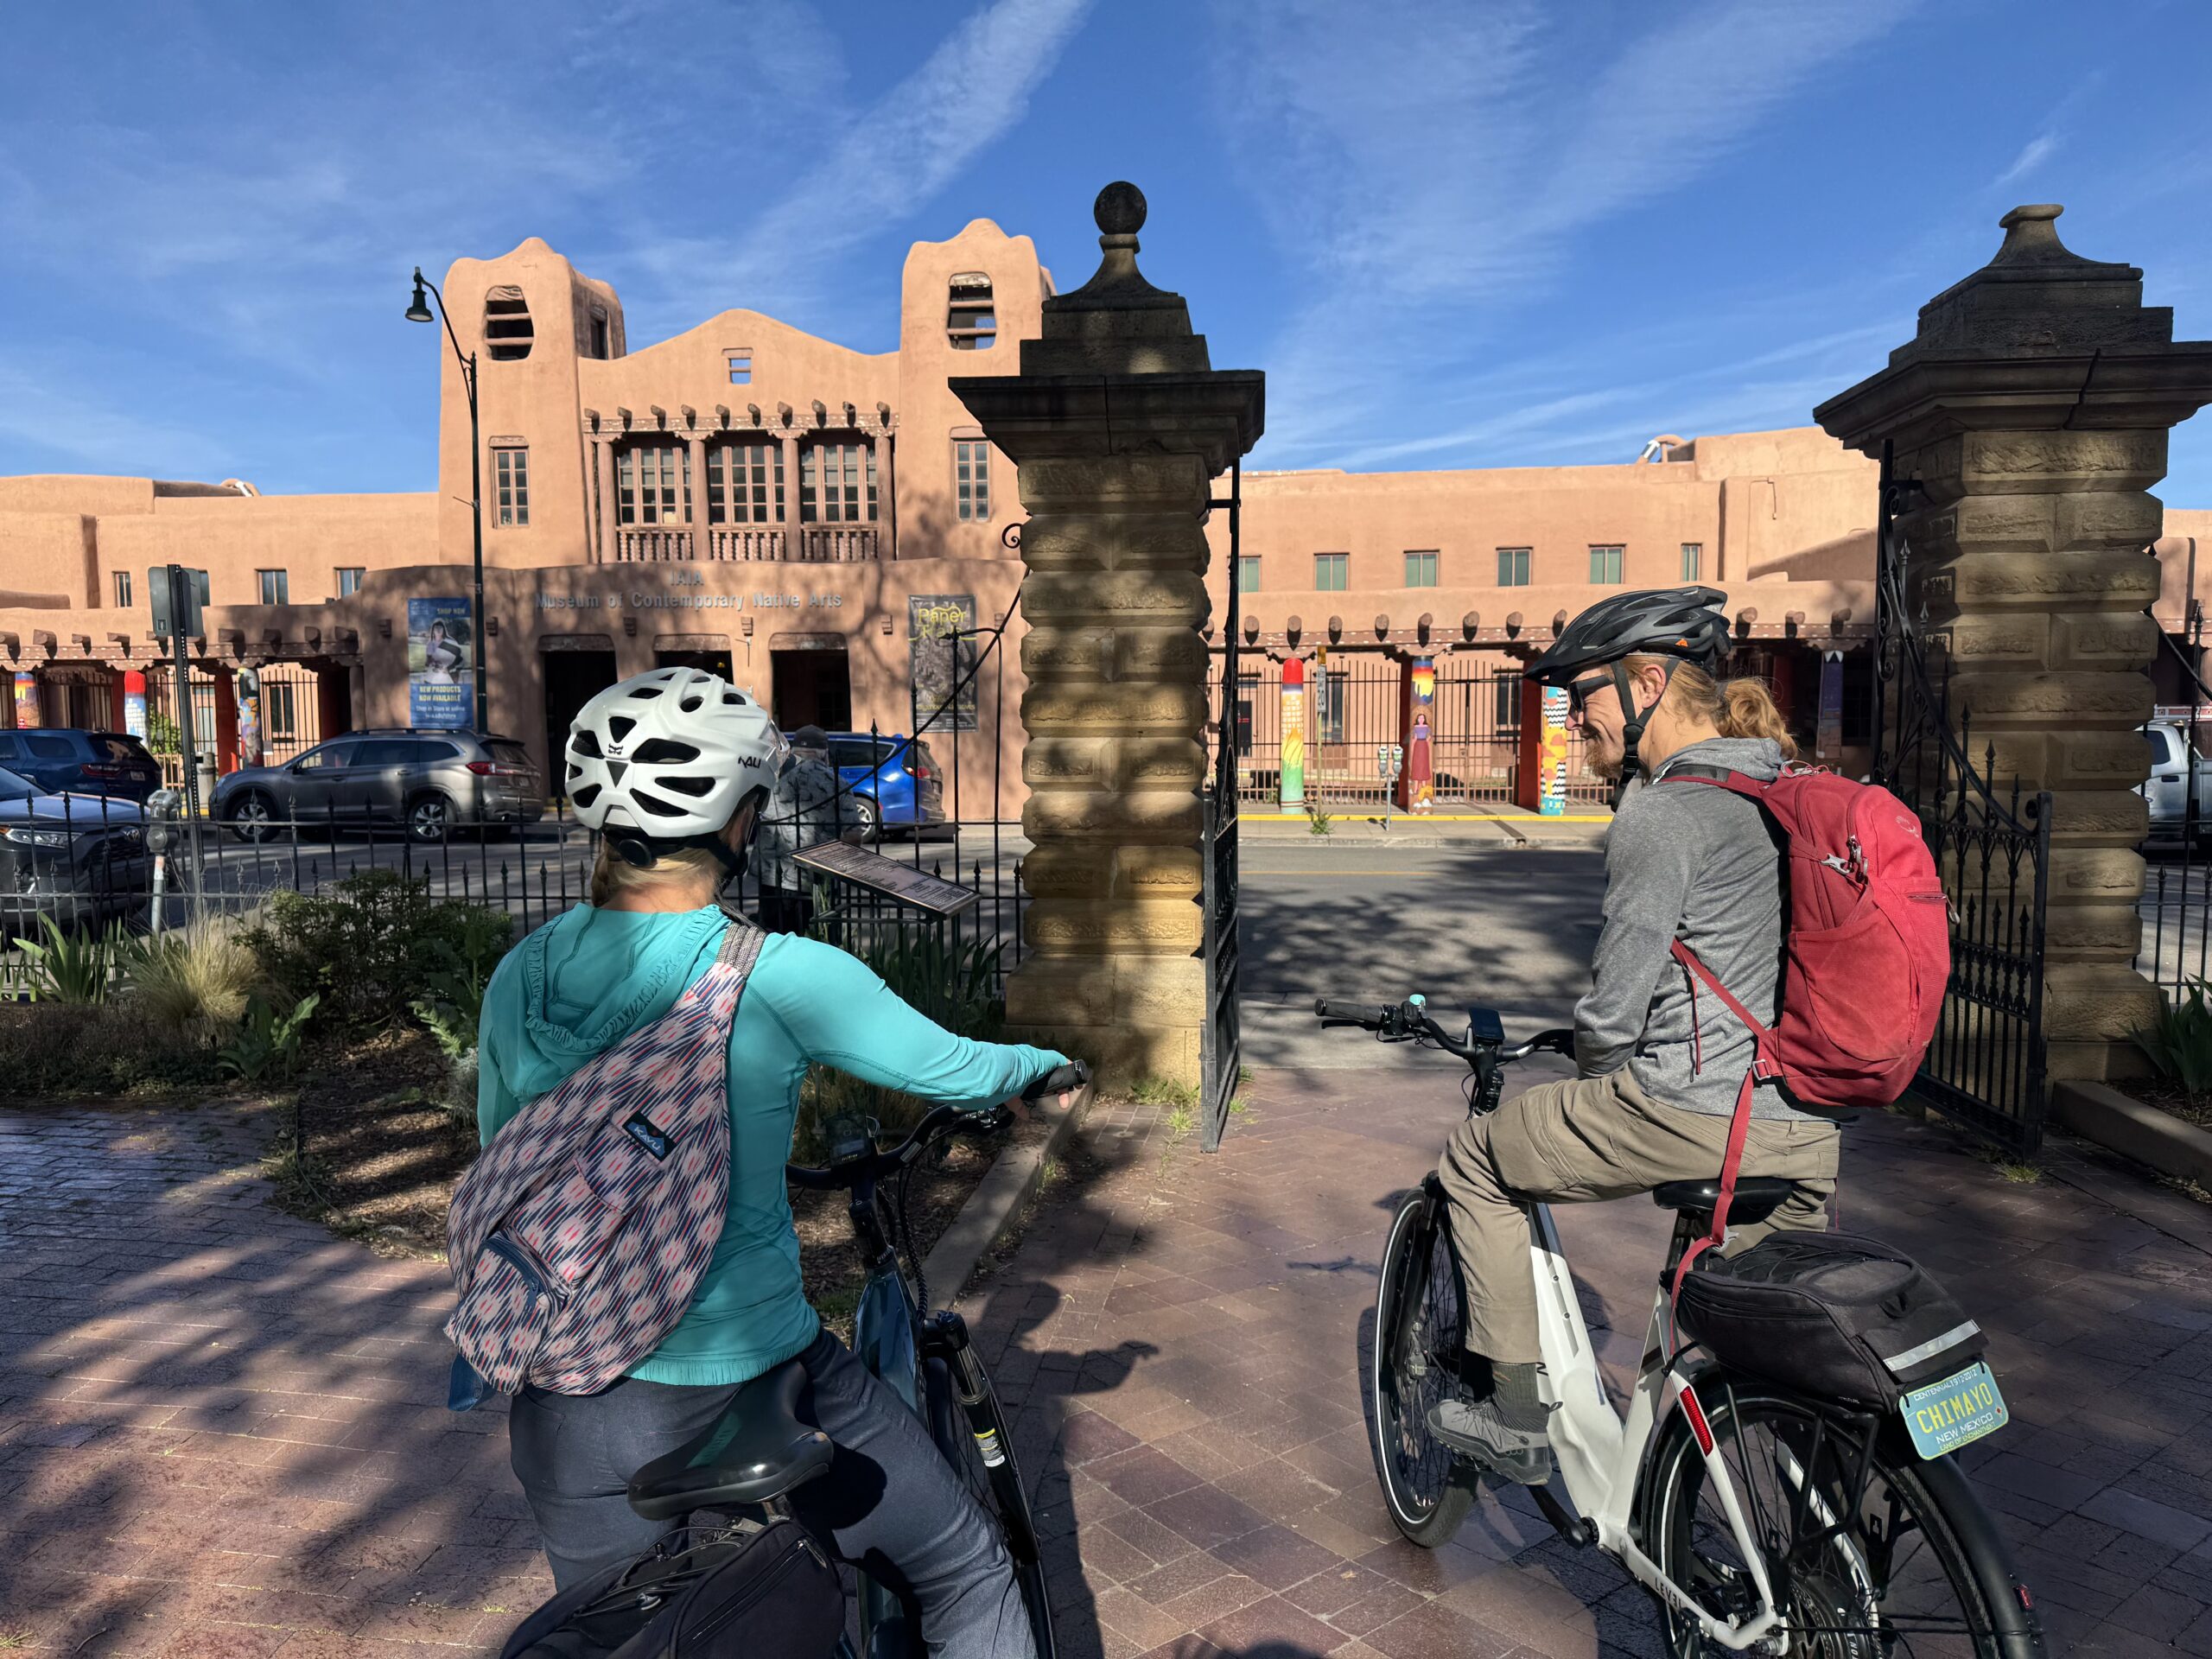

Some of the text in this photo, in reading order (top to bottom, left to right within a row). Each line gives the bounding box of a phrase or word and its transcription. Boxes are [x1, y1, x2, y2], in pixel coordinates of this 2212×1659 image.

[670, 569, 704, 586] IAIA
[535, 590, 843, 612] Museum of Contemporary Native Arts
[918, 607, 967, 626] Paper
[634, 1126, 661, 1151] KAVU
[1916, 1382, 1993, 1433] CHIMAYO
[1936, 1412, 1993, 1445] NEW MEXICO
[1940, 1421, 1996, 1452] LAND OF ENCHANTMENT
